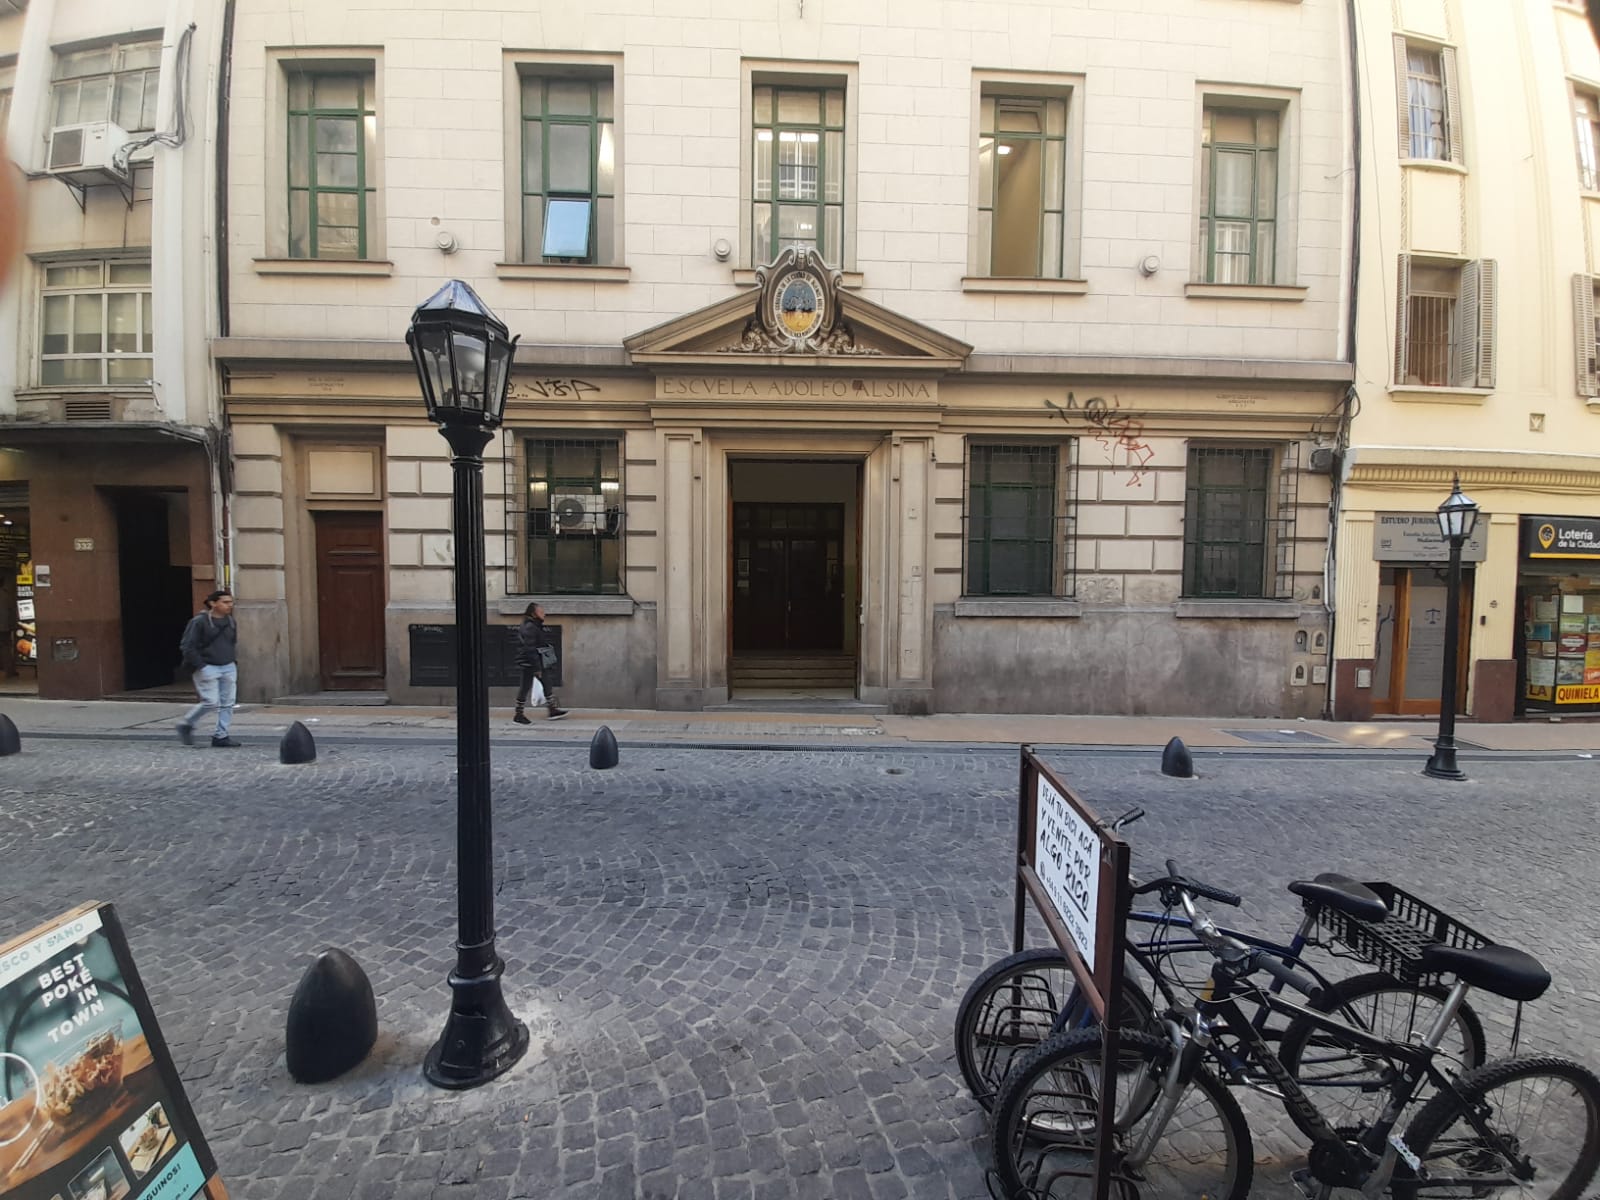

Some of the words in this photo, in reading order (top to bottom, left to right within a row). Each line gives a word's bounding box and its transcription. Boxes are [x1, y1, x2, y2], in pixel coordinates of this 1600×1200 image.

[663, 378, 757, 395] ESCVELA
[768, 379, 847, 396] ADOLFO
[855, 380, 930, 398] ALSINA
[1558, 527, 1593, 541] Lotería
[1558, 539, 1568, 548] de
[1569, 540, 1576, 548] la
[1577, 540, 1600, 549] Ciudad
[1529, 685, 1548, 697] LA
[1558, 687, 1599, 701] QUINIELA
[1056, 801, 1063, 819] TU
[1064, 812, 1077, 836] BICI
[1078, 830, 1094, 858] ACÁ
[1041, 807, 1046, 821] Y
[1074, 849, 1091, 888] POR
[1040, 828, 1063, 872] ALGO
[1064, 862, 1089, 912] RICO
[0, 950, 29, 974] SCO
[33, 941, 43, 953] Y
[46, 922, 84, 948] SANO
[38, 952, 85, 990] BEST
[78, 985, 99, 1004] IN
[47, 1000, 105, 1044] TOWN
